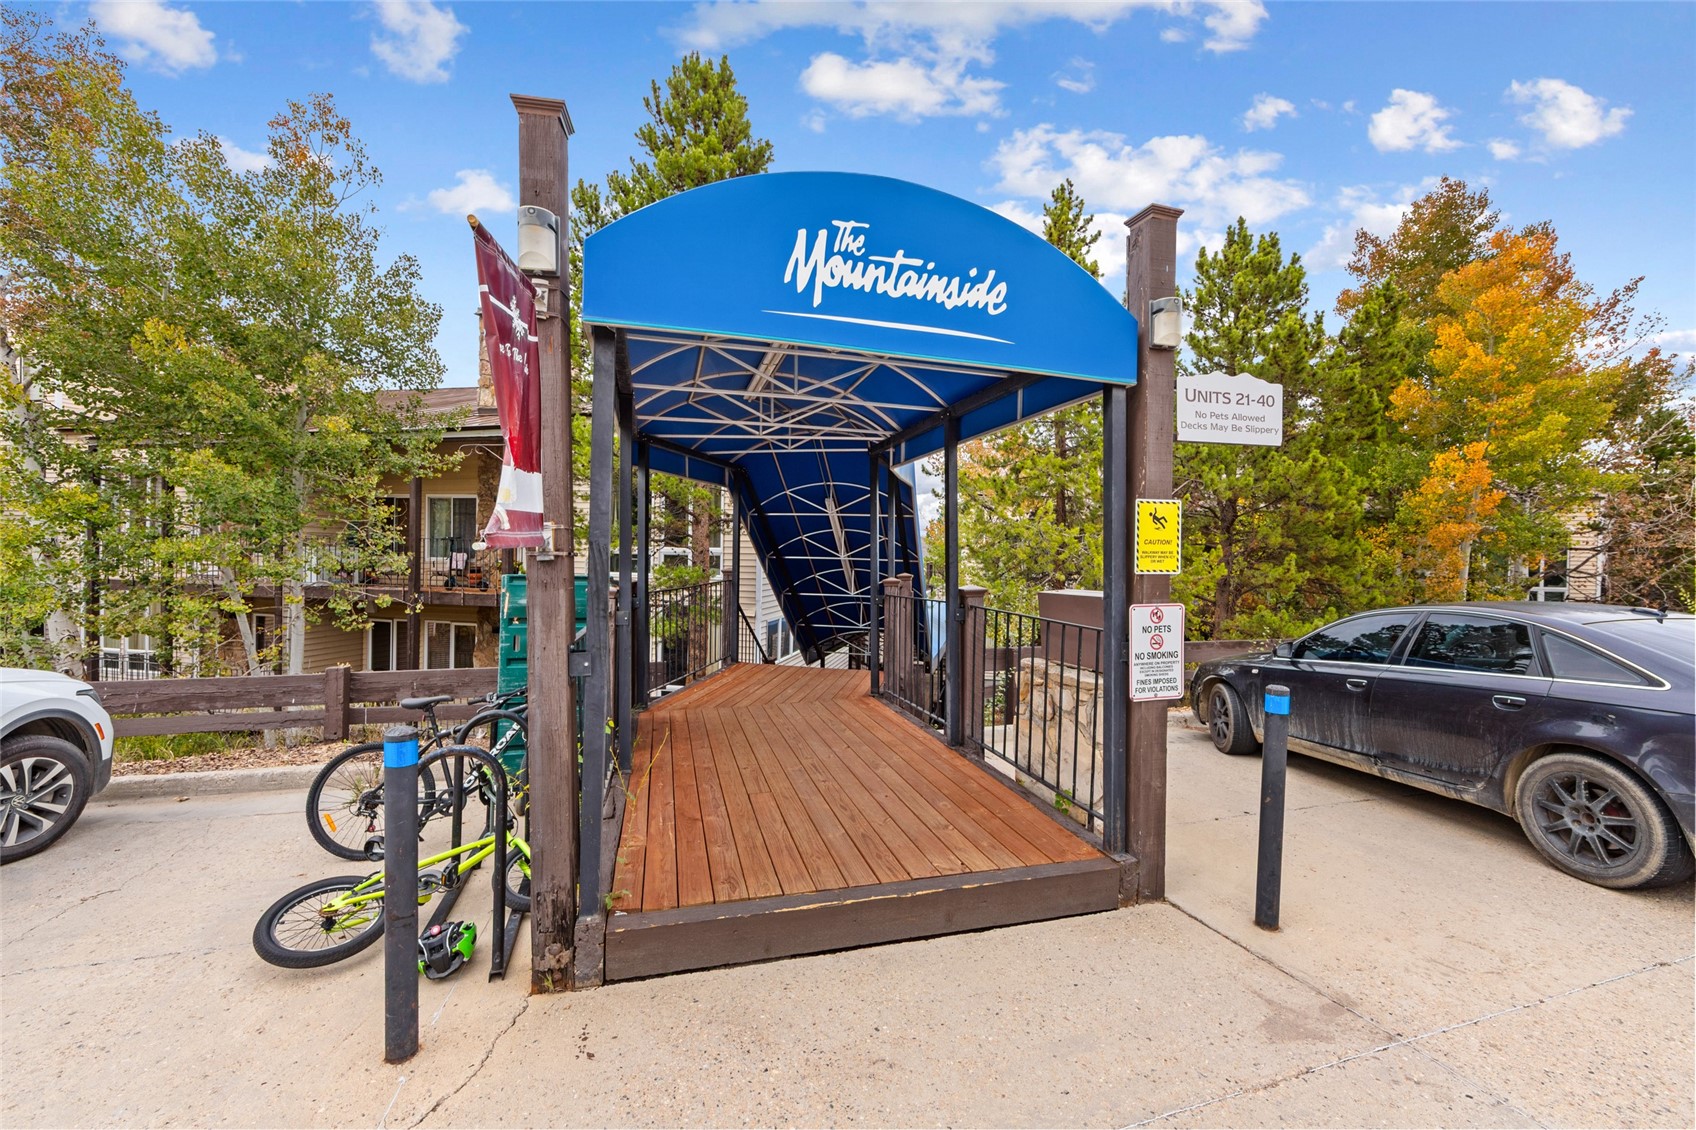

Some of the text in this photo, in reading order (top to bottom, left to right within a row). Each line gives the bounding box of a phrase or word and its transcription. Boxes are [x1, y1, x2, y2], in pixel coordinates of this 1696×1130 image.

[831, 219, 870, 256] The
[783, 228, 1008, 316] Mountainside
[1185, 388, 1275, 407] UNITS 21-40
[1195, 411, 1266, 422] No Pets Allowed
[1181, 421, 1279, 435] Decks May Be Slippery
[1154, 625, 1171, 633] PETS
[1147, 651, 1178, 660] SMOKING
[1147, 685, 1178, 693] VIOLATIONS
